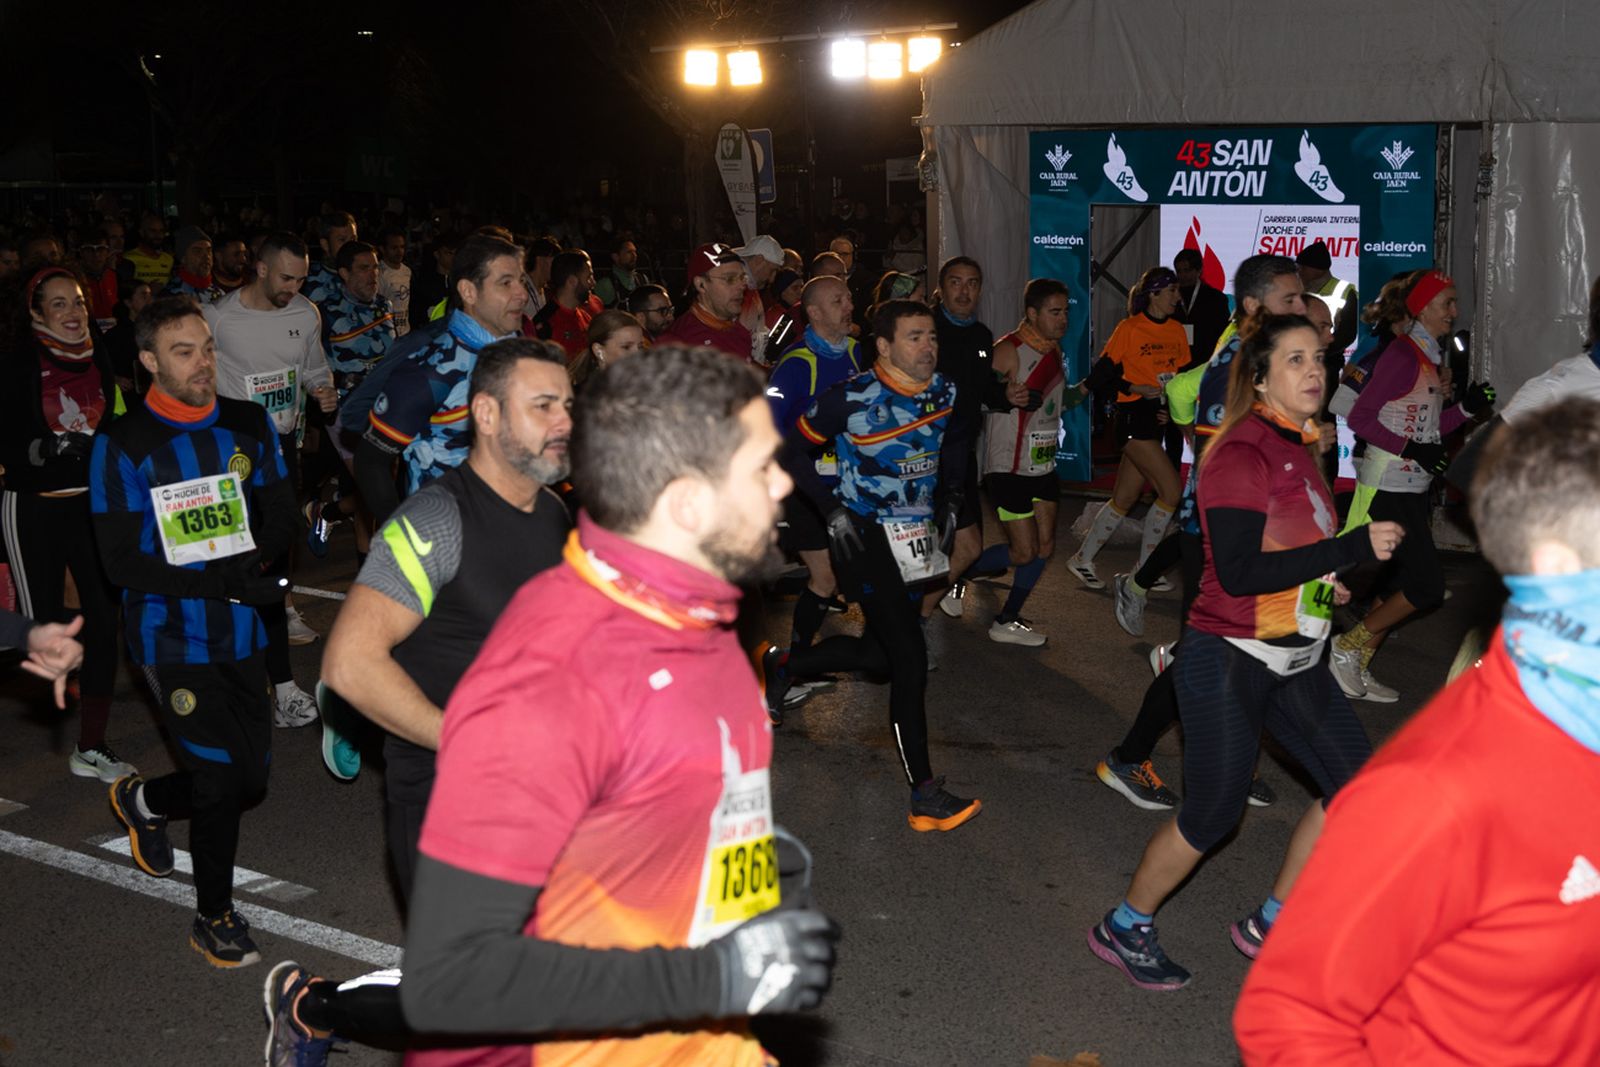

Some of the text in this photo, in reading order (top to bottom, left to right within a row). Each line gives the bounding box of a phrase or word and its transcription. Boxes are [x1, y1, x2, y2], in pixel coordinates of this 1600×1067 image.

[1176, 139, 1273, 168] 43 SAN
[1116, 172, 1133, 190] 43
[1168, 163, 1267, 197] ANTÓN
[1309, 170, 1328, 191] 43
[1394, 172, 1420, 180] RURAL
[1033, 234, 1084, 245] calderón
[1262, 226, 1308, 234] NOCHE DE
[1258, 236, 1306, 256] SAN
[1364, 241, 1426, 252] calderón
[262, 387, 292, 408] 7798
[201, 485, 211, 493] DE
[177, 503, 233, 534] 1363
